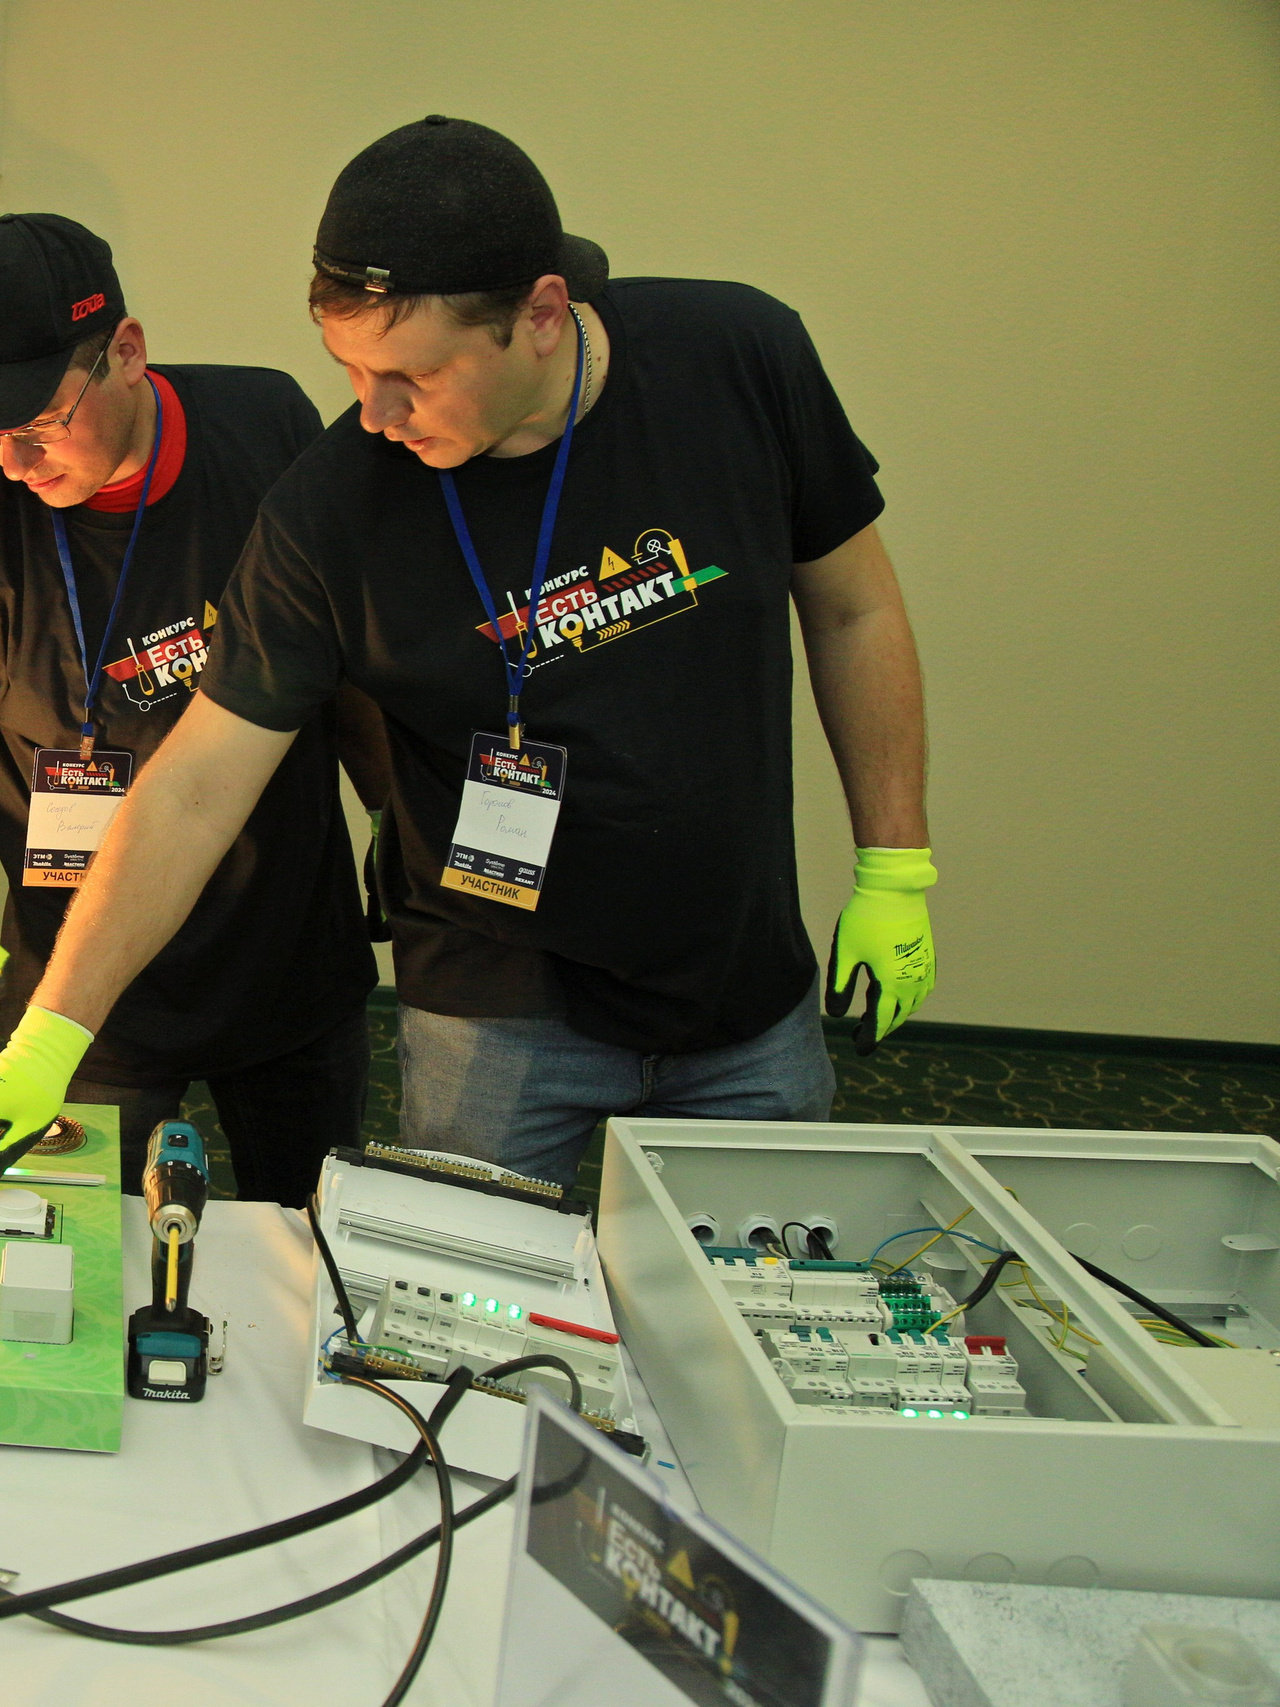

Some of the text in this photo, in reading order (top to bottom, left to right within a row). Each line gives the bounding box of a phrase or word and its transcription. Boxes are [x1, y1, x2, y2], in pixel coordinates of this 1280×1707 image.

[141, 616, 196, 647] КОНКУРС
[541, 787, 557, 796] 2024
[42, 871, 86, 882] УЧАСТ
[460, 874, 521, 900] УЧАСТНИК
